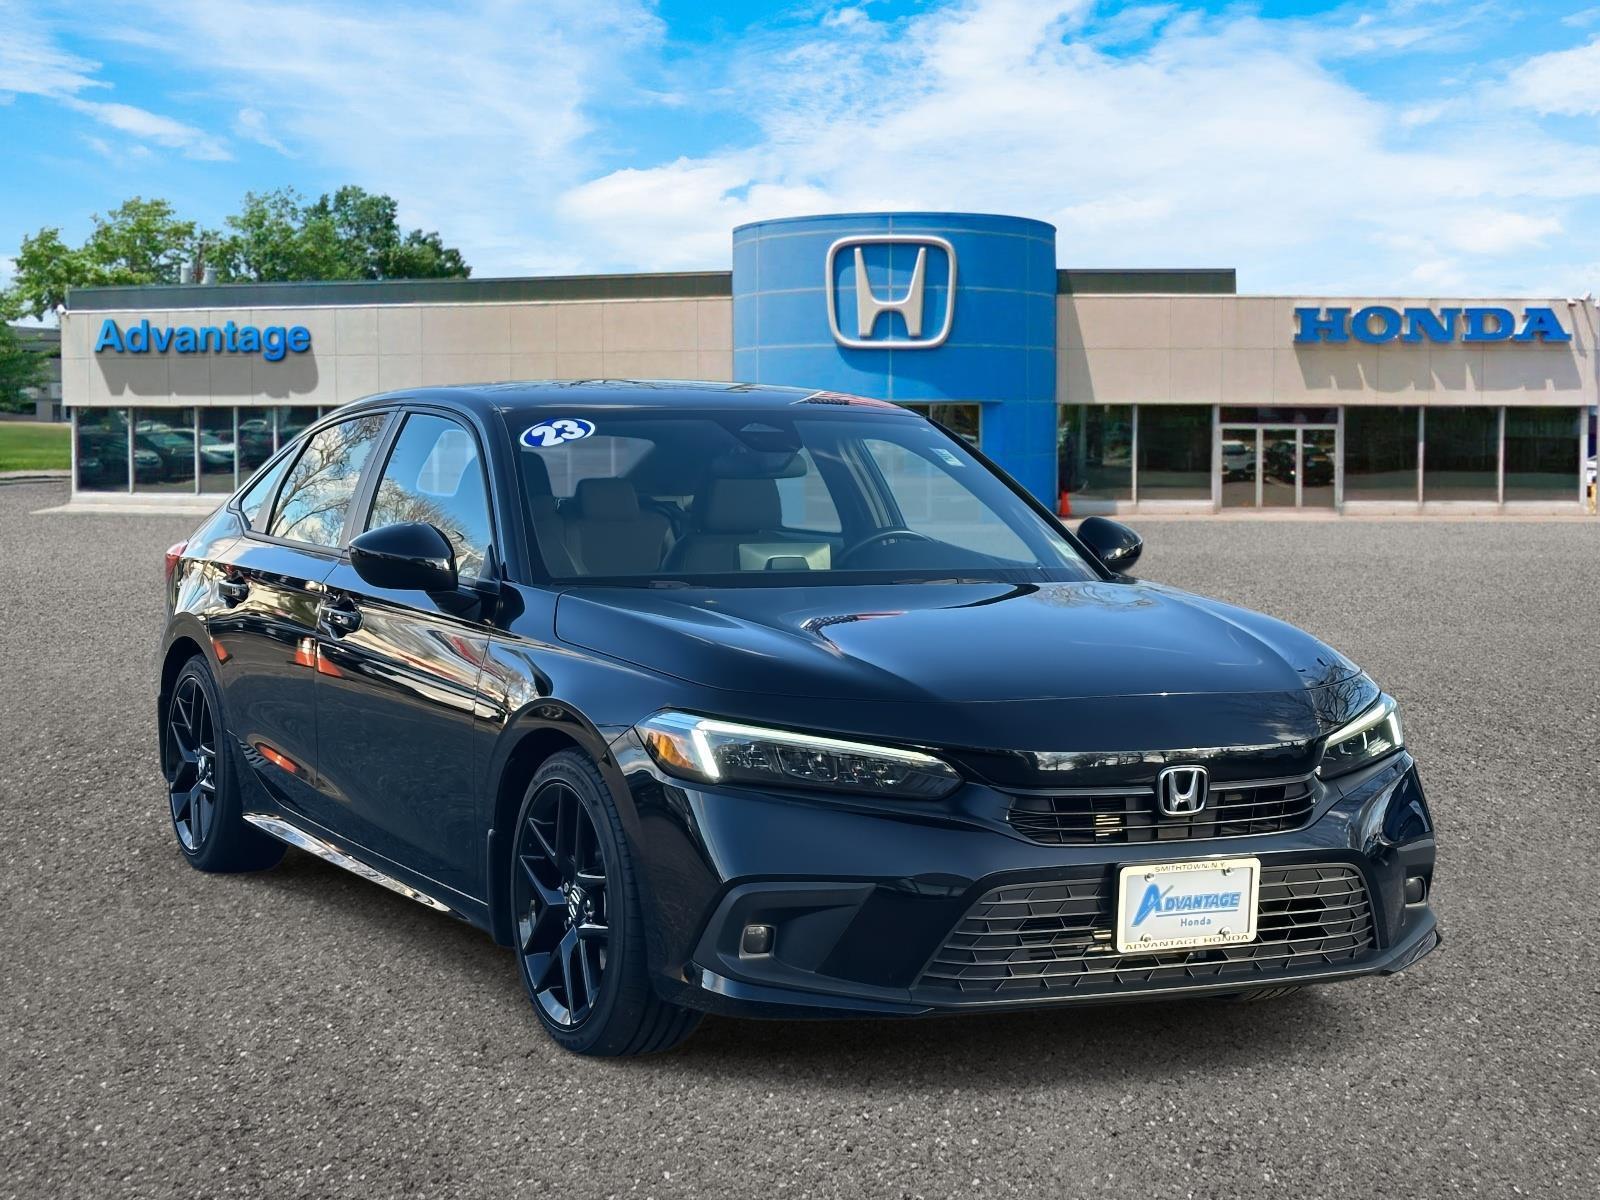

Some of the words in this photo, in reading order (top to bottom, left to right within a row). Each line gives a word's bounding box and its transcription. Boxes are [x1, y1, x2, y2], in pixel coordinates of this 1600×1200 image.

[94, 319, 312, 362] Advantage
[1294, 305, 1572, 344] HONDA
[531, 419, 586, 447] 23
[1131, 883, 1242, 927] ADVANTAGE
[1180, 917, 1212, 927] Honda
[1125, 939, 1197, 950] ADVANTAGE
[1203, 934, 1249, 943] HONDA
